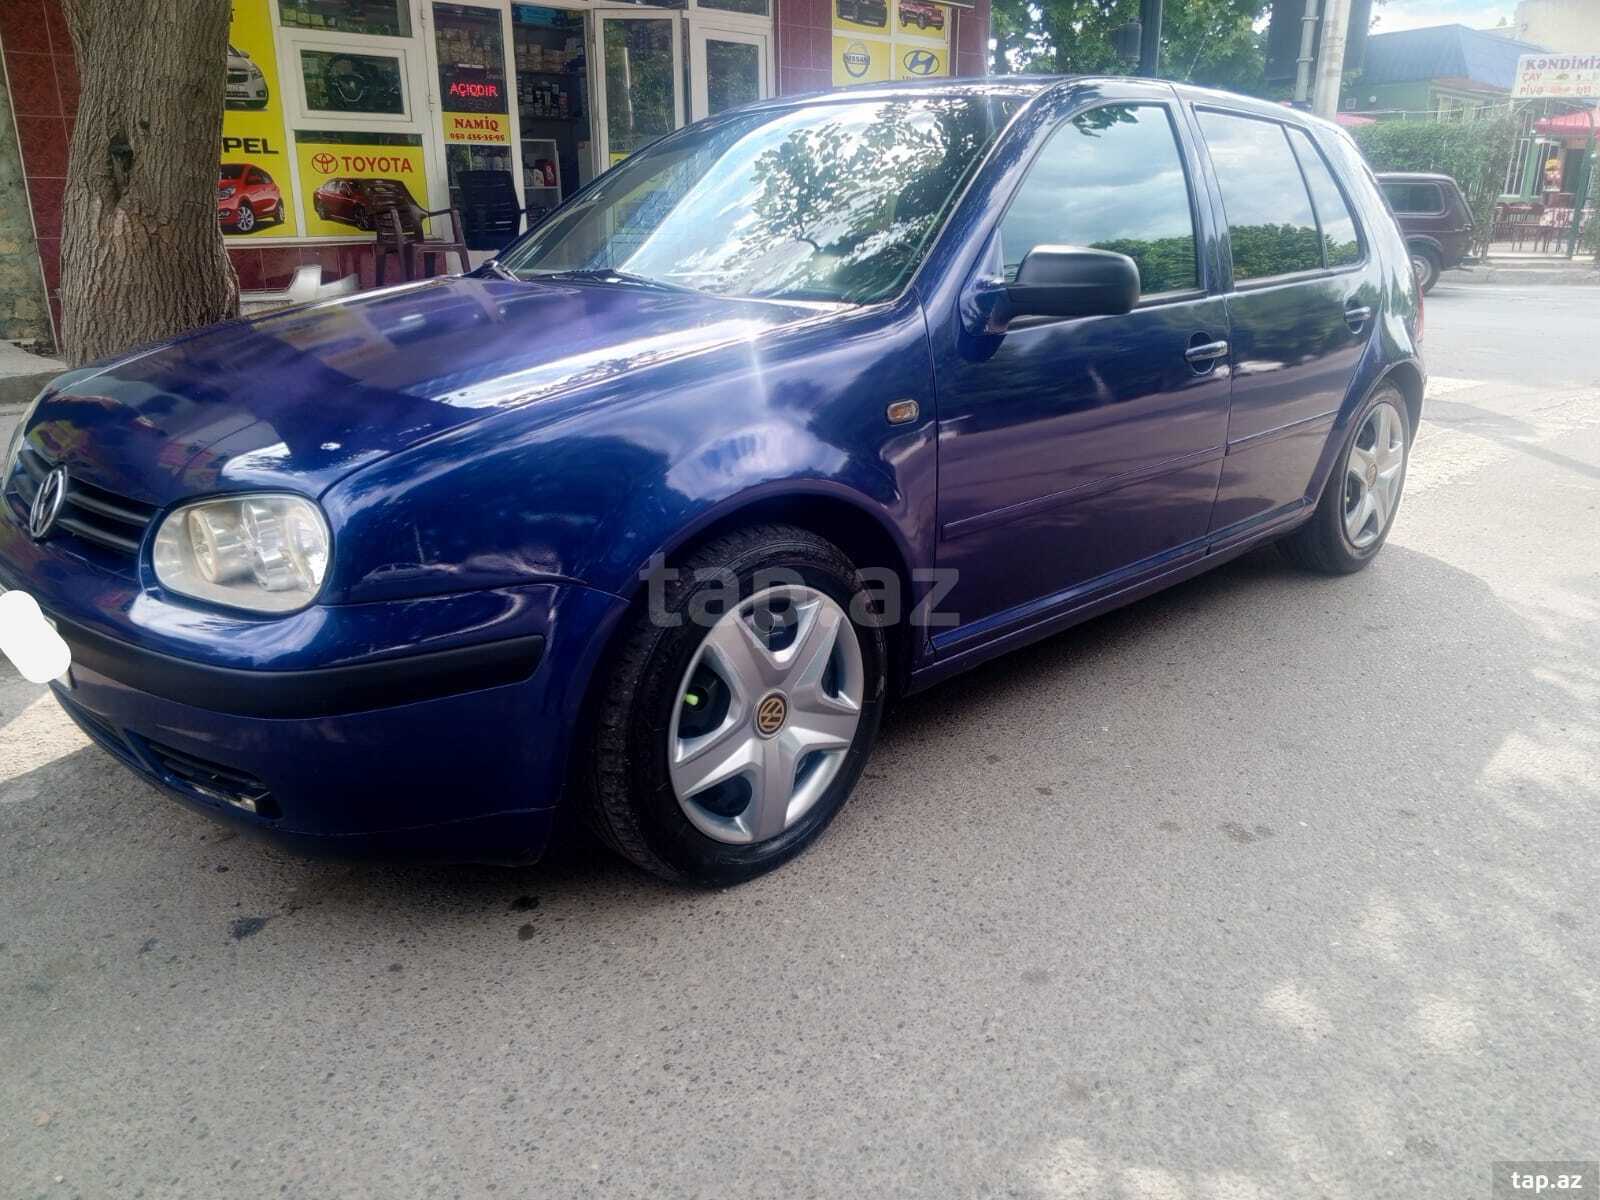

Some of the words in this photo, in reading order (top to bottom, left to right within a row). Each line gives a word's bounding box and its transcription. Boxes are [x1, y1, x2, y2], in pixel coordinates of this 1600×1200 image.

[454, 116, 499, 132] NAMİQ
[222, 137, 279, 154] PEL
[341, 156, 413, 173] TOYOTA
